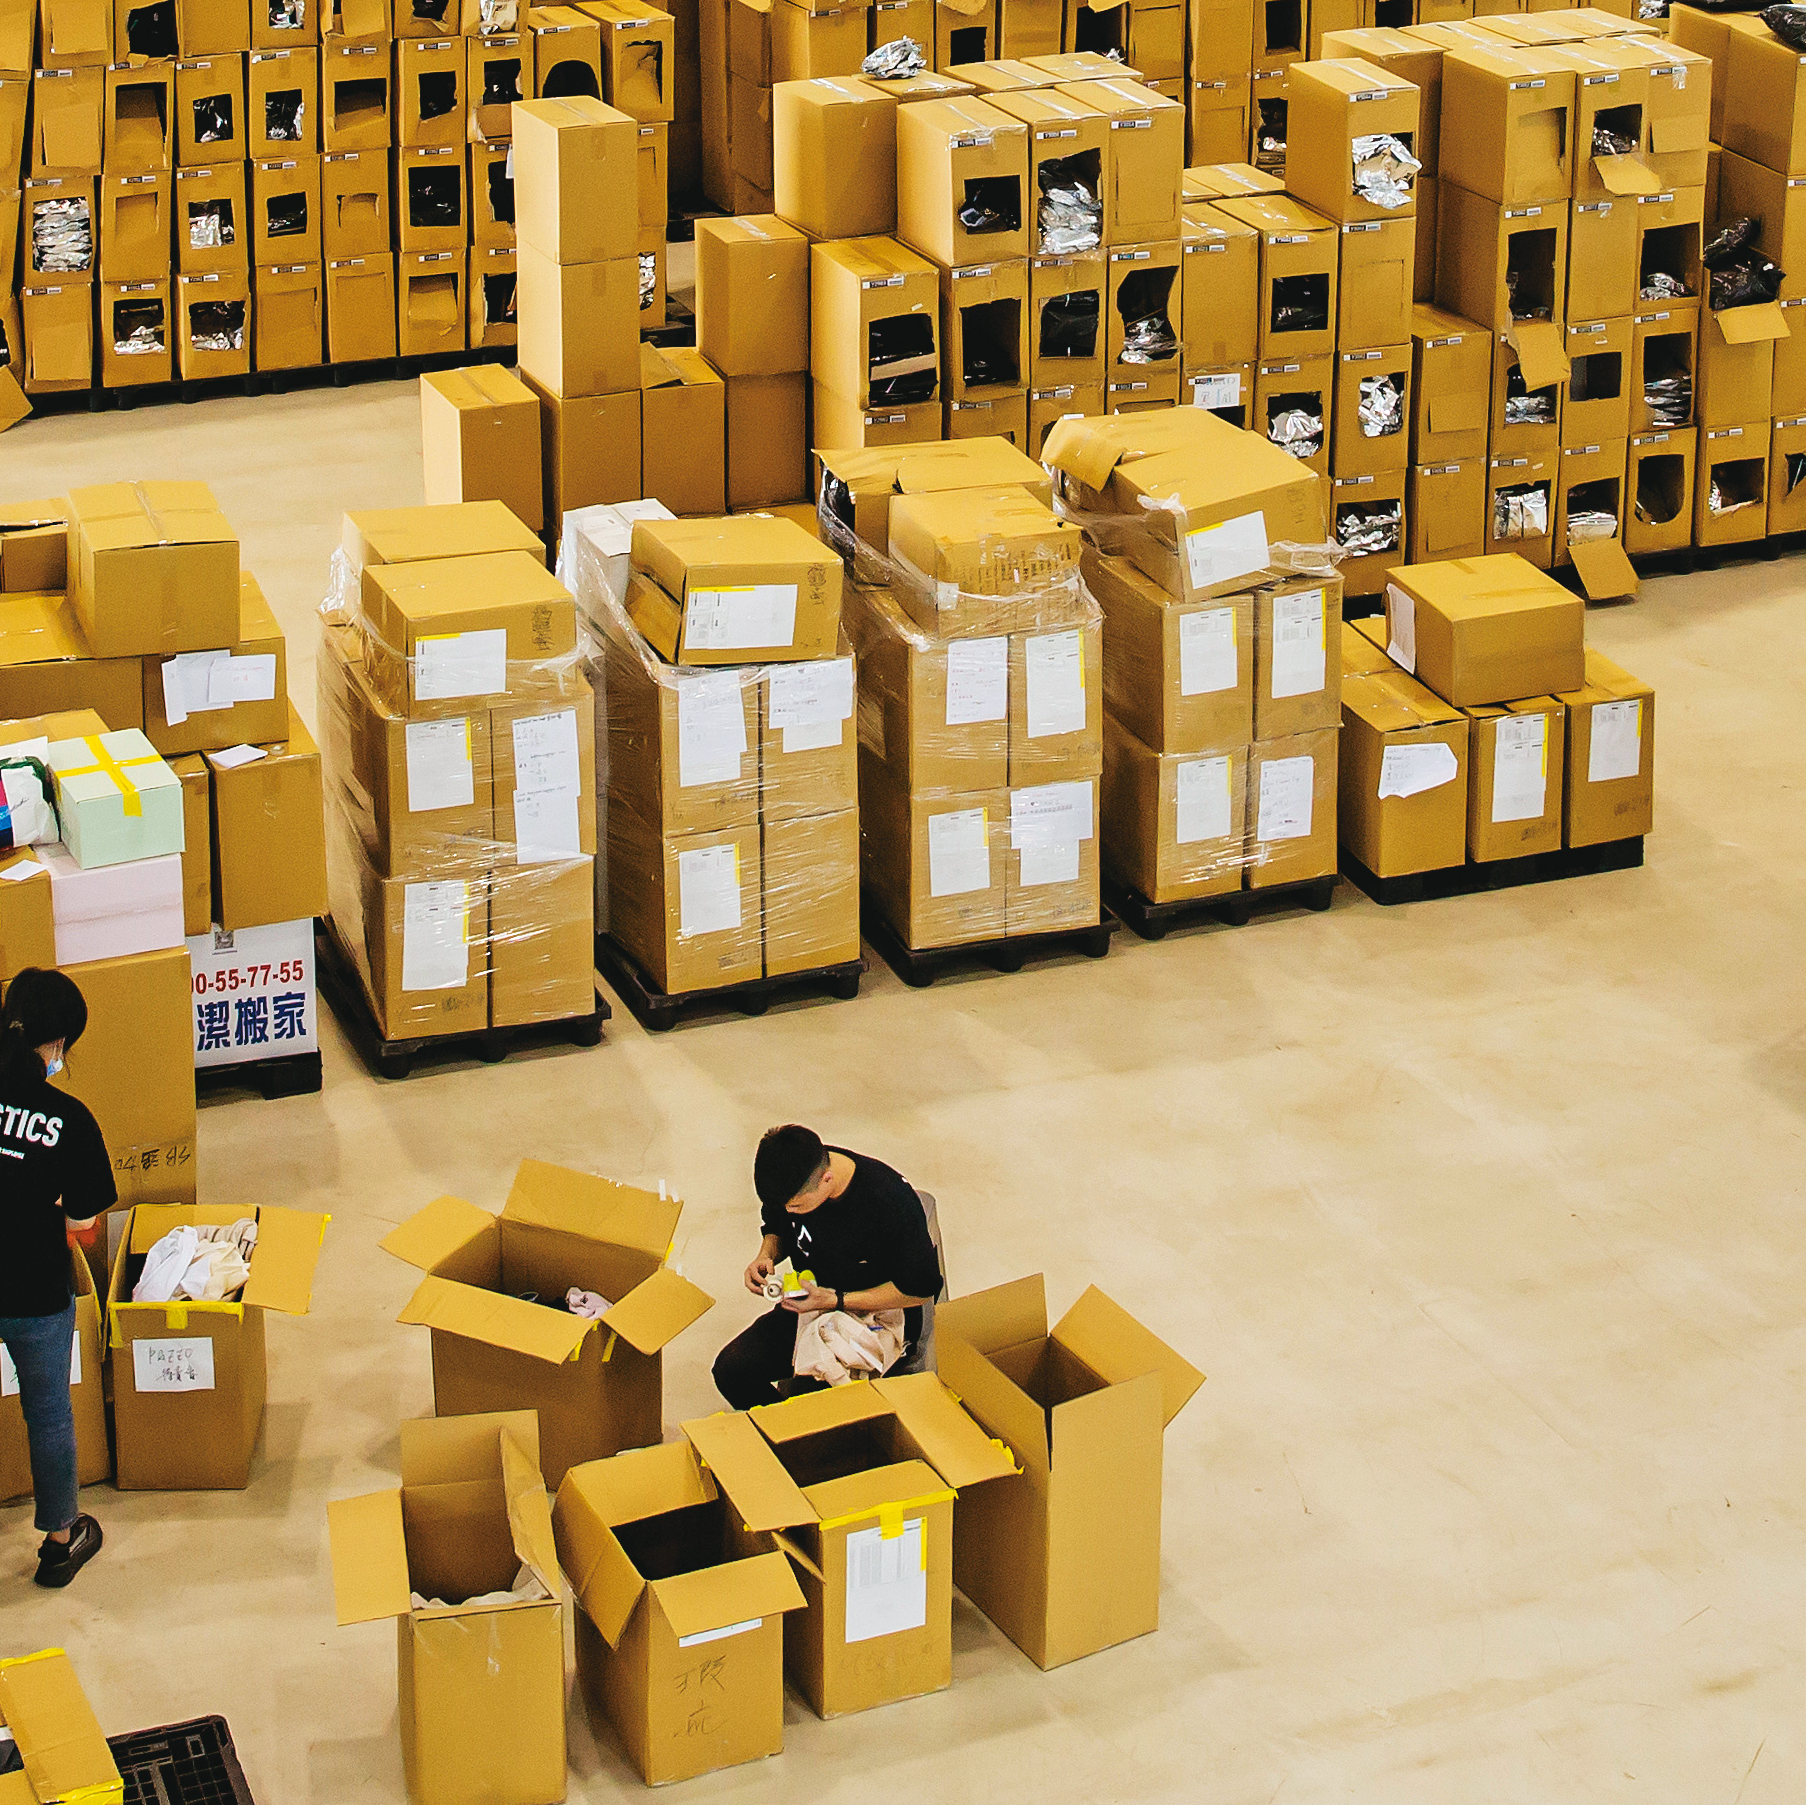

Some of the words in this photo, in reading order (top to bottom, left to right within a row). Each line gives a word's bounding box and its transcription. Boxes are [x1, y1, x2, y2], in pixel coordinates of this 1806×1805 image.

[191, 959, 304, 995] 0-55-77-55
[196, 991, 307, 1051] 潔搬家
